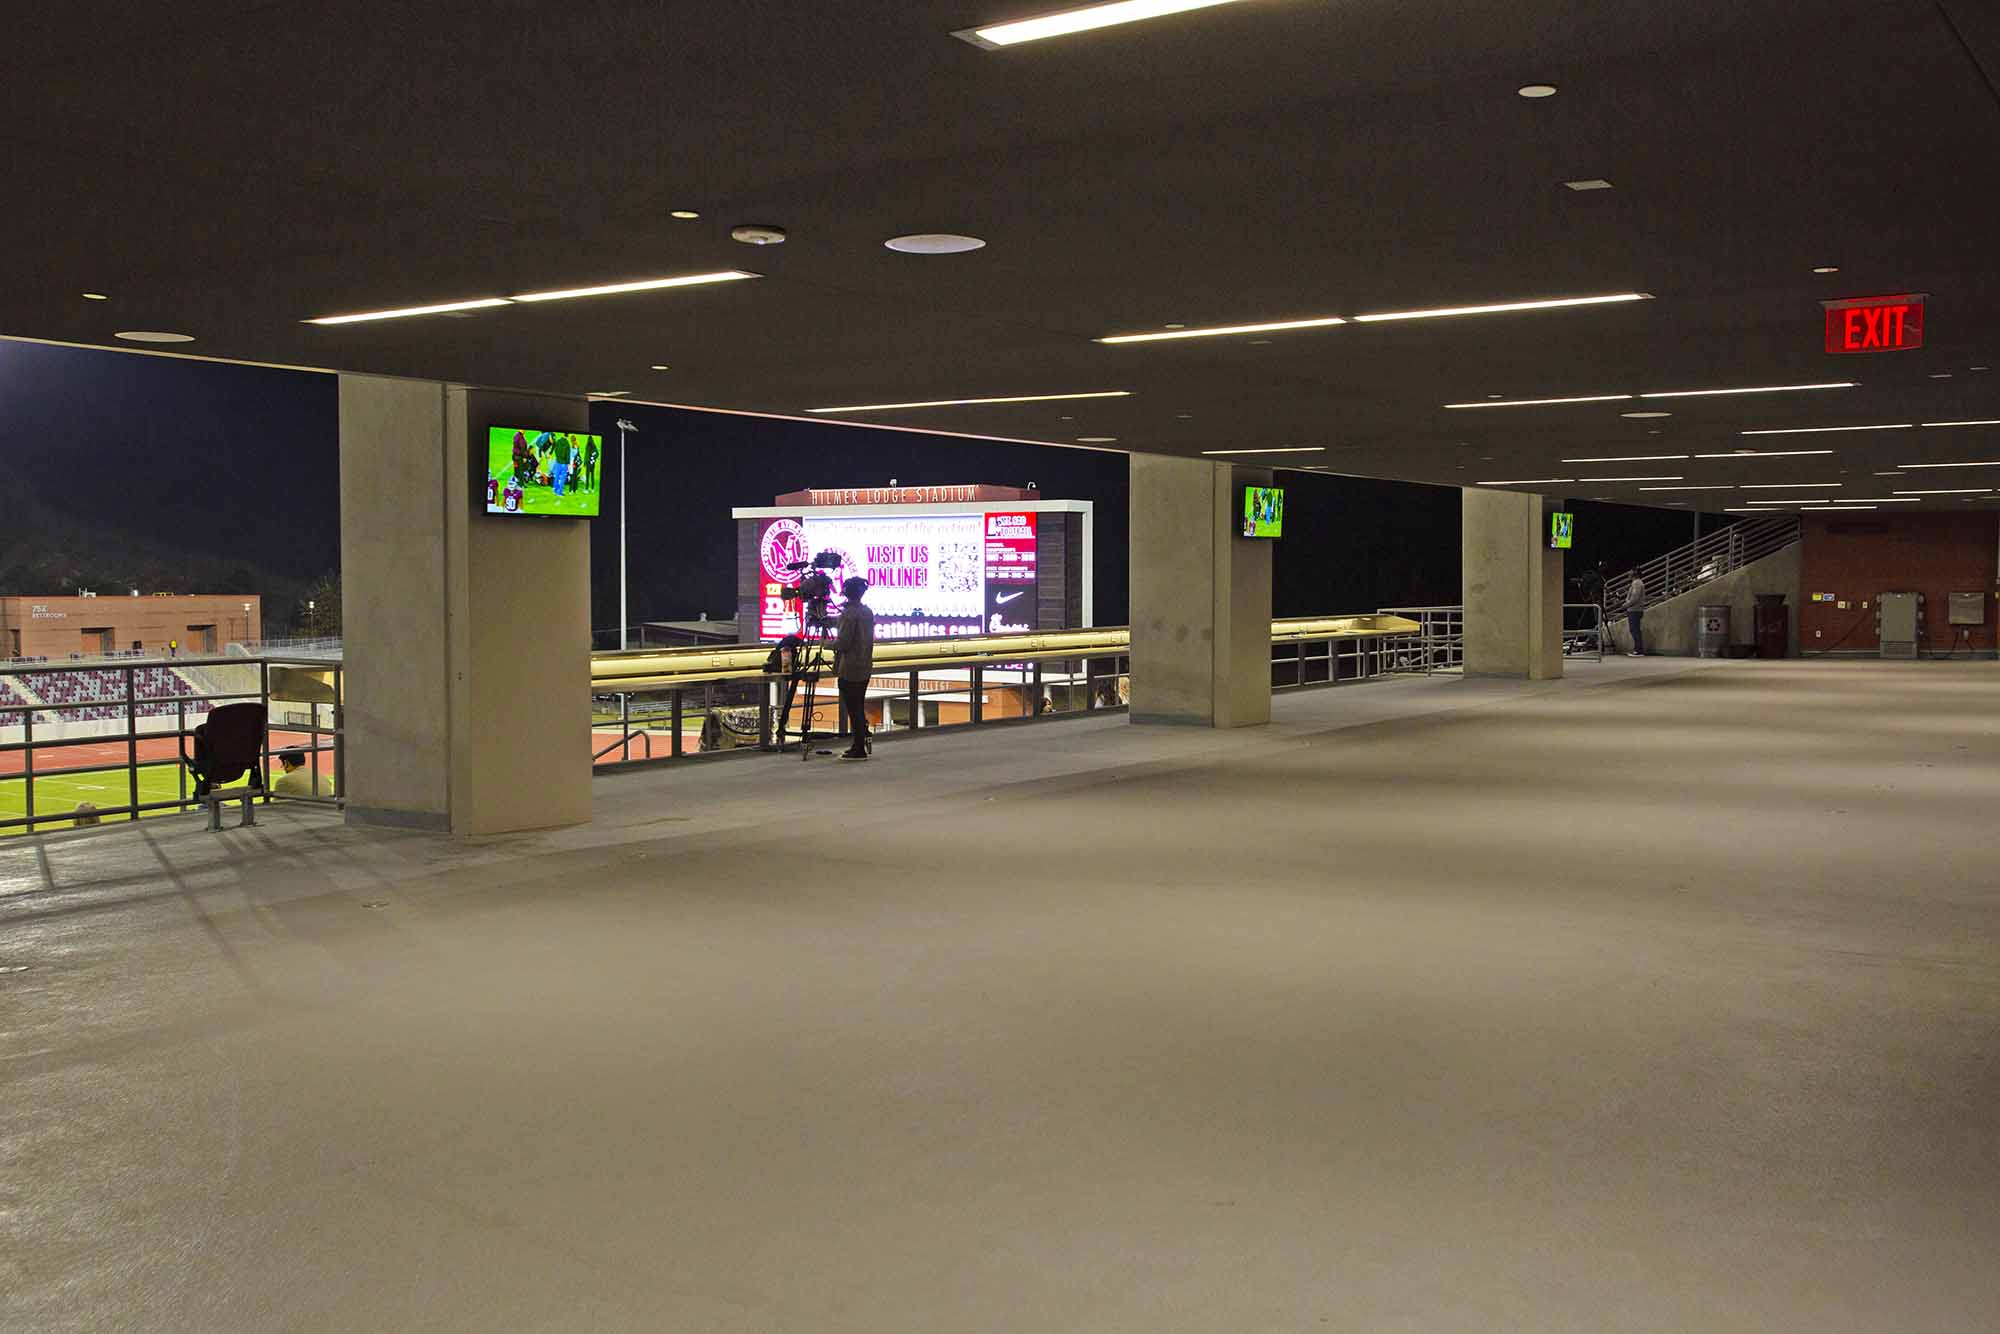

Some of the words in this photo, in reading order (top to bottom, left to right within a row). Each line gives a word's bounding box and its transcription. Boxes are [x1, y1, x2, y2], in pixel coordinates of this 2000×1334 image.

[1844, 305, 1909, 349] EXIT
[811, 491, 858, 505] HILMER
[867, 489, 907, 504] LODGE
[916, 487, 977, 503] STADIUM
[867, 545, 904, 563] VISIT
[911, 545, 929, 563] US
[867, 567, 928, 587] ONLINE!
[873, 621, 981, 639] cathletics.com
[918, 680, 951, 691] OLLEGE
